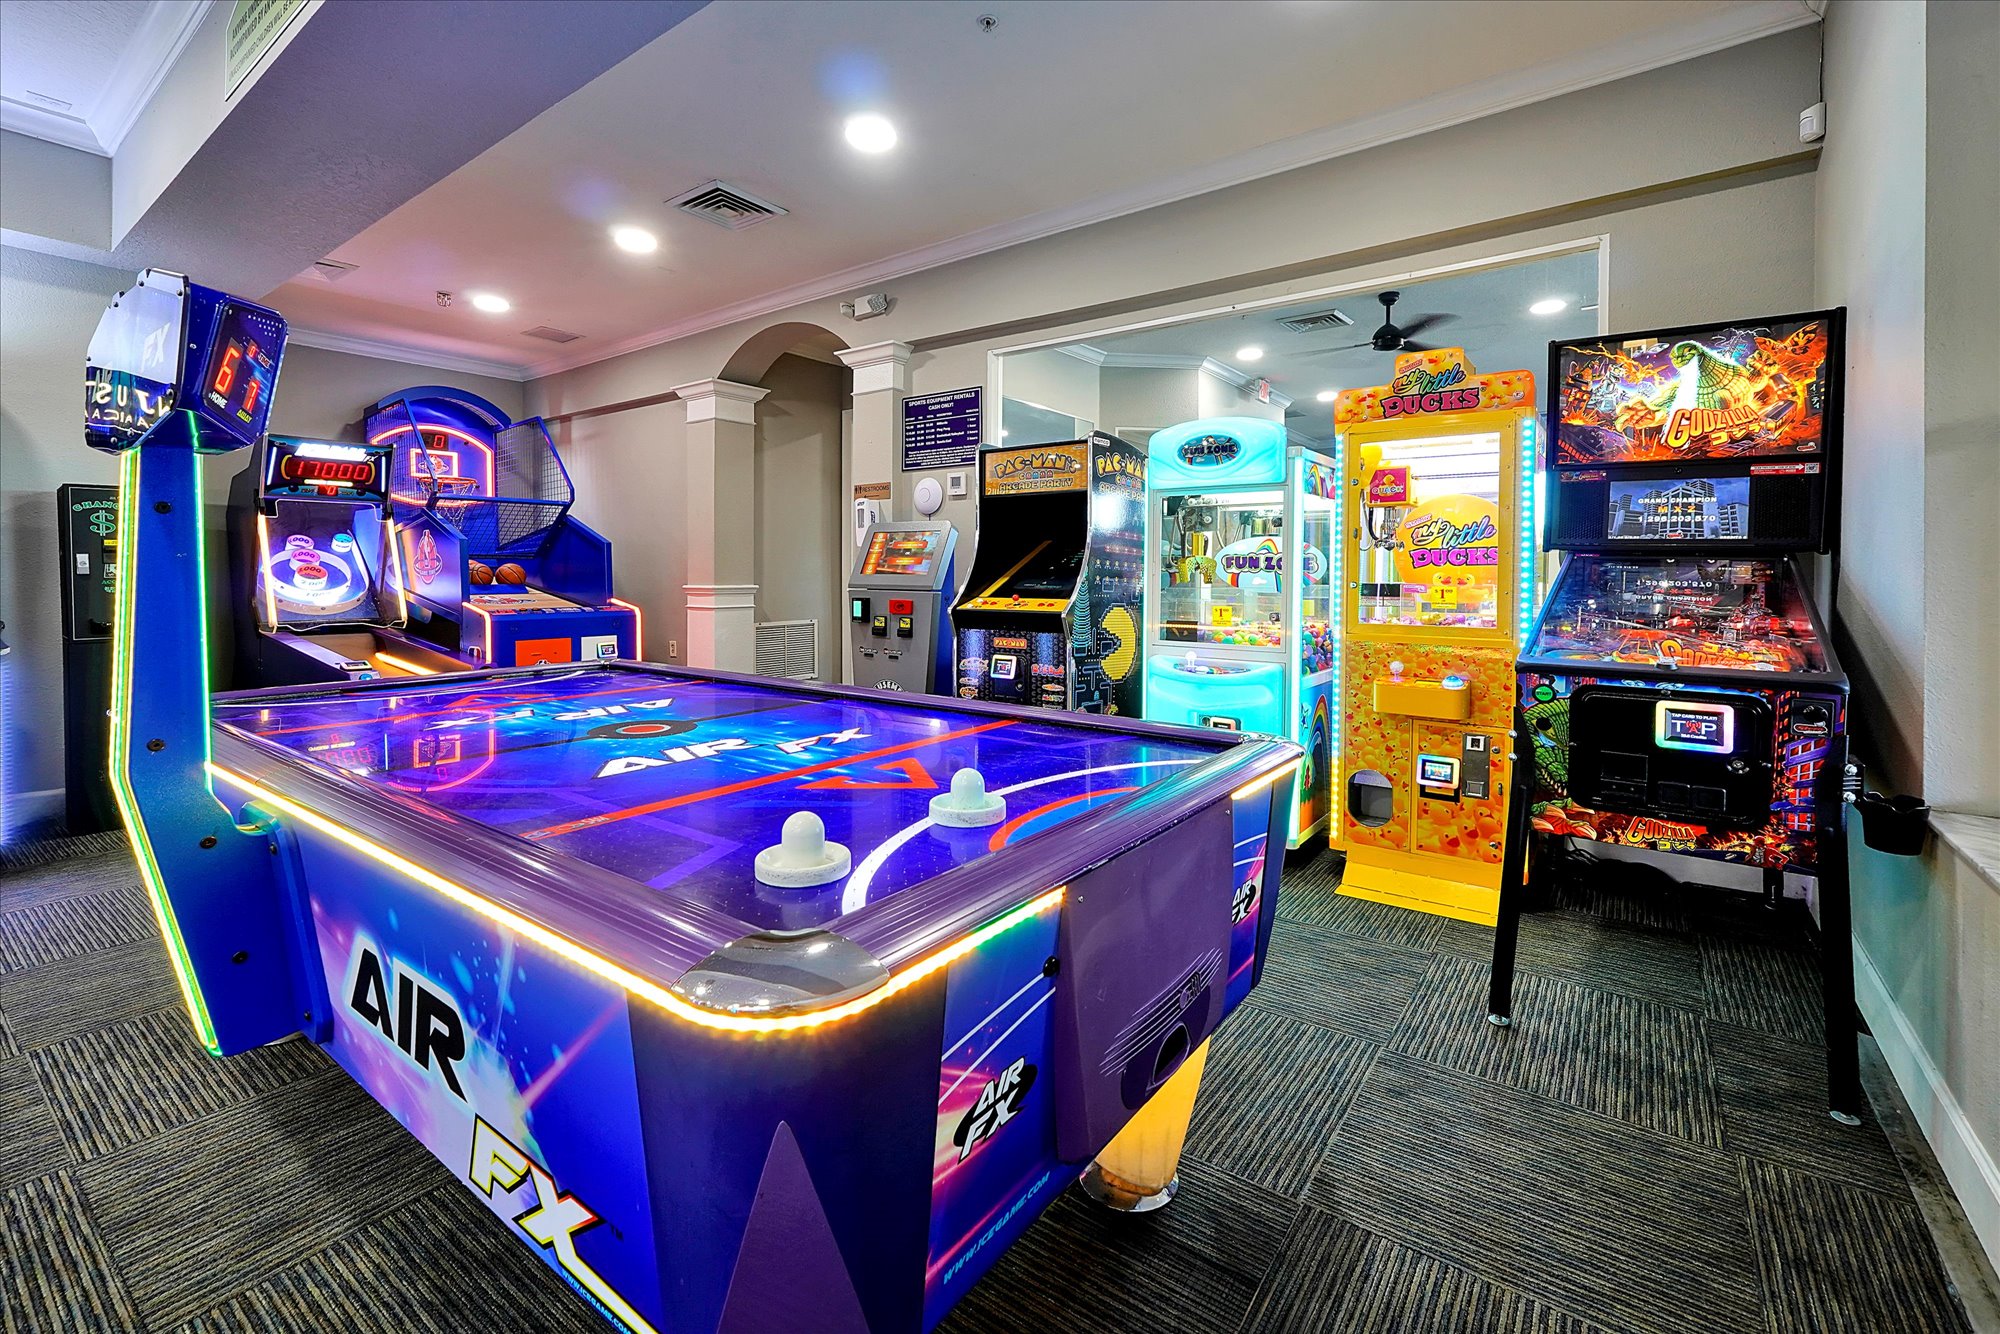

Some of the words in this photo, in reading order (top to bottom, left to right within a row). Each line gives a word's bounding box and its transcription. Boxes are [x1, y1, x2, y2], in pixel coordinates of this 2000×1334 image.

[211, 391, 228, 409] HOME
[927, 396, 953, 404] EQUIPMENT
[1381, 388, 1480, 418] DUCKS
[1666, 405, 1760, 448] GODZILLA
[1183, 445, 1205, 456] FUN
[1206, 444, 1236, 455] ZONE
[994, 453, 1080, 479] PAC-MAN'S
[862, 485, 890, 493] RESTROOMS
[999, 480, 1039, 492] ARCADE
[1040, 478, 1074, 489] PARTY
[1225, 555, 1260, 570] FUN
[1410, 547, 1498, 569] DUCKS
[995, 639, 1026, 648] PAC-MAN
[1671, 719, 1717, 735] TAP
[590, 738, 758, 779] AIR
[776, 728, 872, 754] FX
[1626, 816, 1696, 844] GODZILLA
[1232, 879, 1253, 907] AIR
[350, 946, 469, 1104] AIR
[972, 1057, 1025, 1119] AIR
[960, 1087, 1020, 1161] FX
[467, 1112, 625, 1285] FX
[944, 1170, 1050, 1285] WWW.ICEGAME.COM
